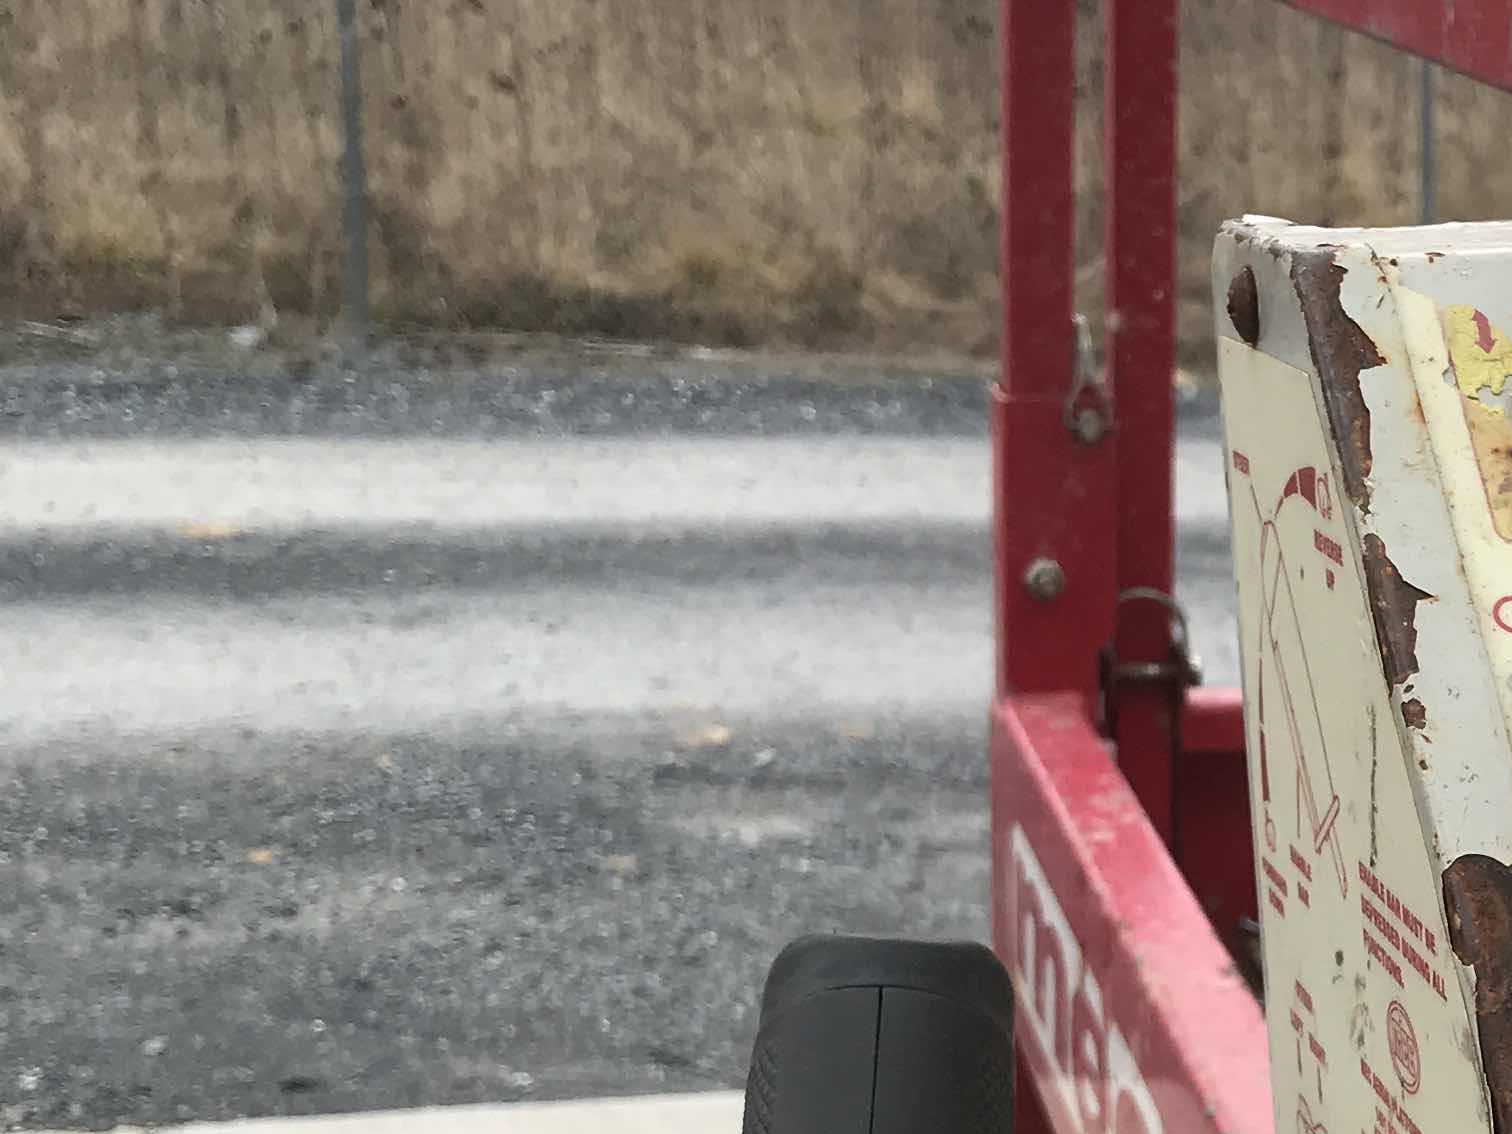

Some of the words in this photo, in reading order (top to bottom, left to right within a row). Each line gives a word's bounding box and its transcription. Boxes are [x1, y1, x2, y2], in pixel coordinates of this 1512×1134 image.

[1359, 860, 1385, 904] ENABLE
[1386, 888, 1402, 920] BAR
[1402, 903, 1423, 941] MUST
[1361, 893, 1400, 951] DEPRESSED
[1401, 936, 1431, 984] DURING
[1432, 970, 1448, 1002] ALL
